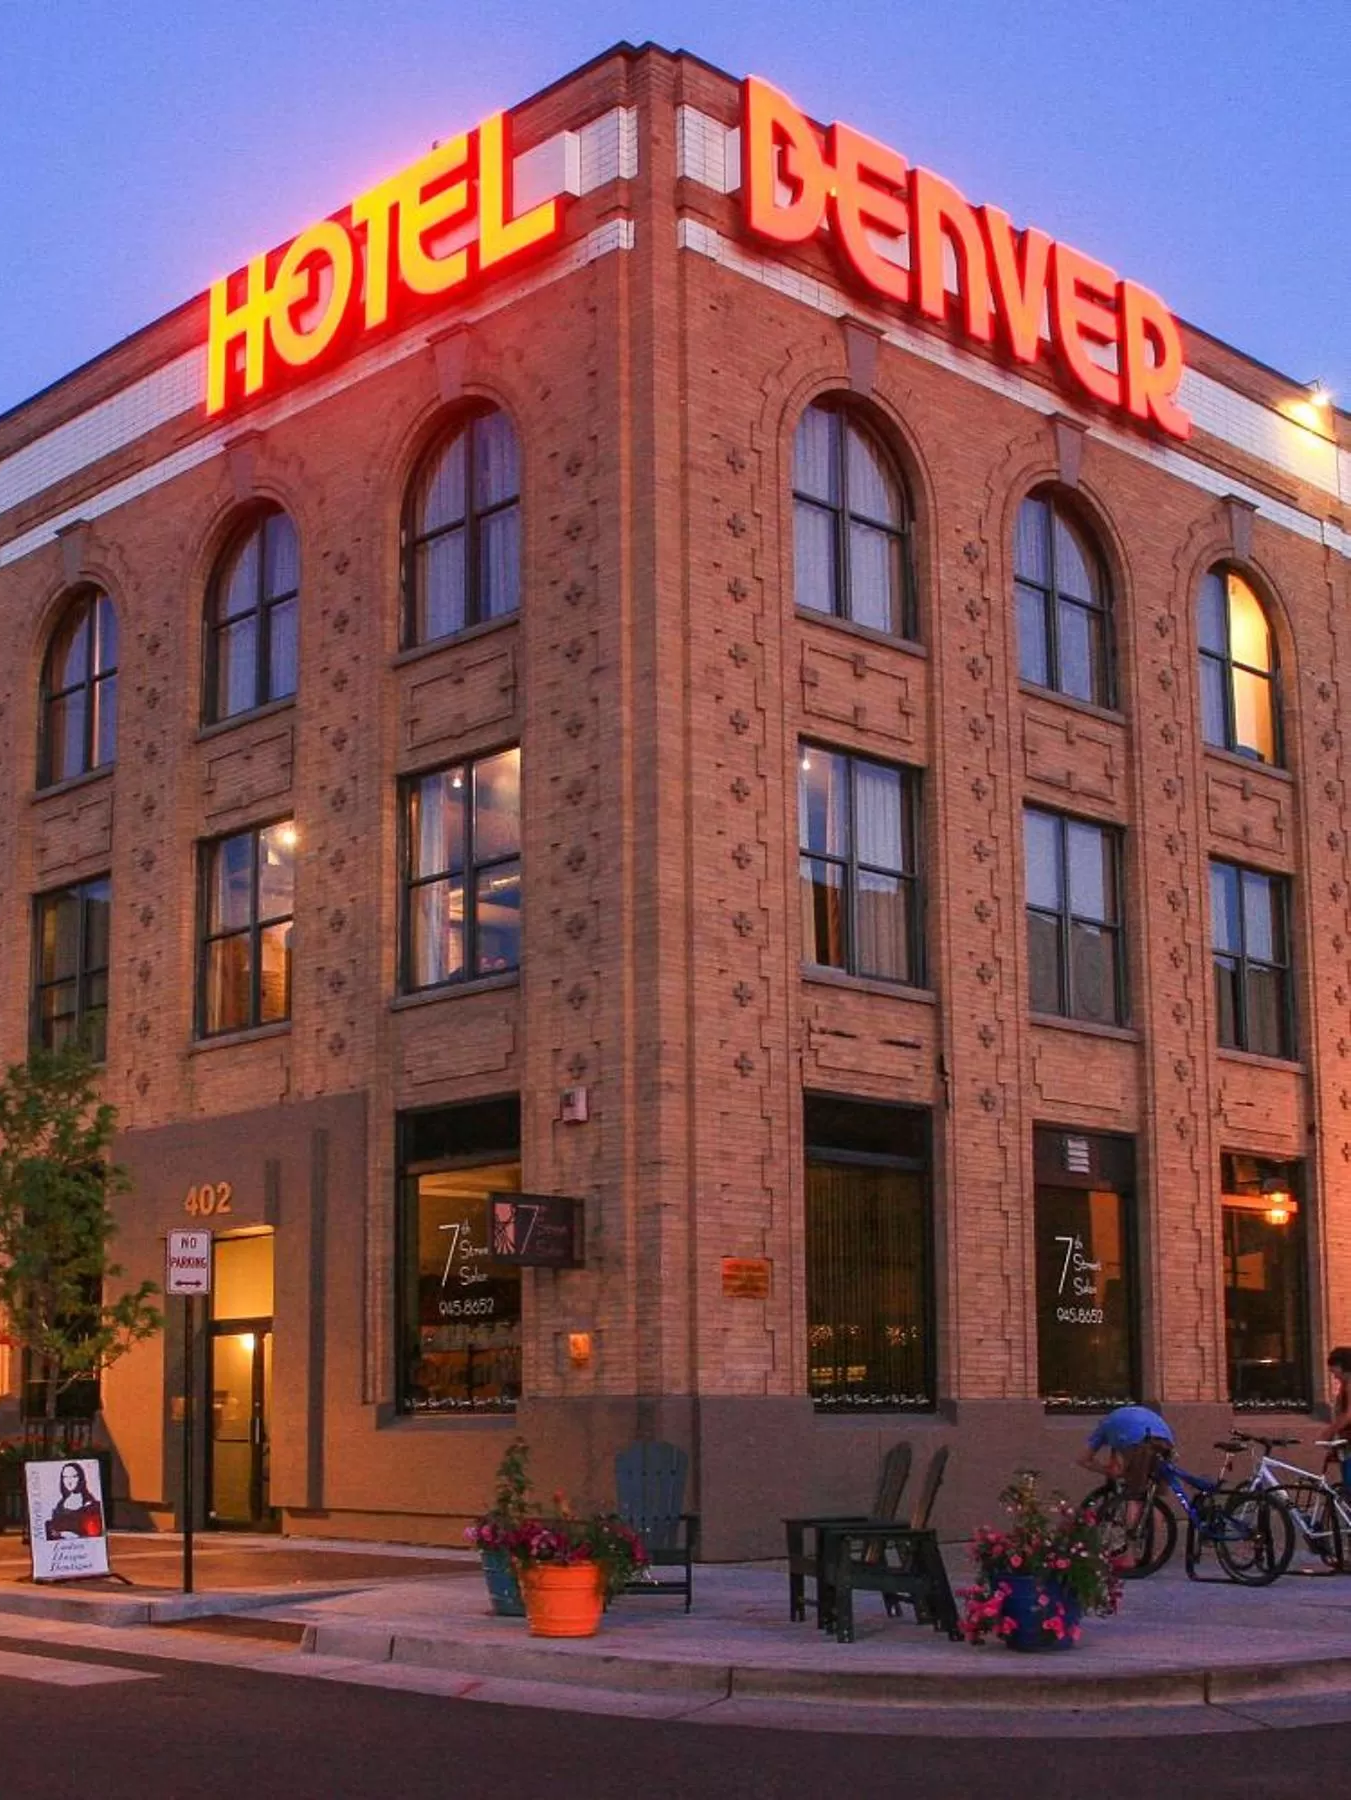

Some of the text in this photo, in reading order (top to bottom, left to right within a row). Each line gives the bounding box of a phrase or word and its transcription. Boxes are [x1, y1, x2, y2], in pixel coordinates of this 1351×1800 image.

[205, 110, 556, 417] HOTEL
[744, 73, 1193, 442] DENVER
[184, 1181, 233, 1217] 402
[180, 1236, 197, 1249] NO
[171, 1256, 208, 1269] PARKING
